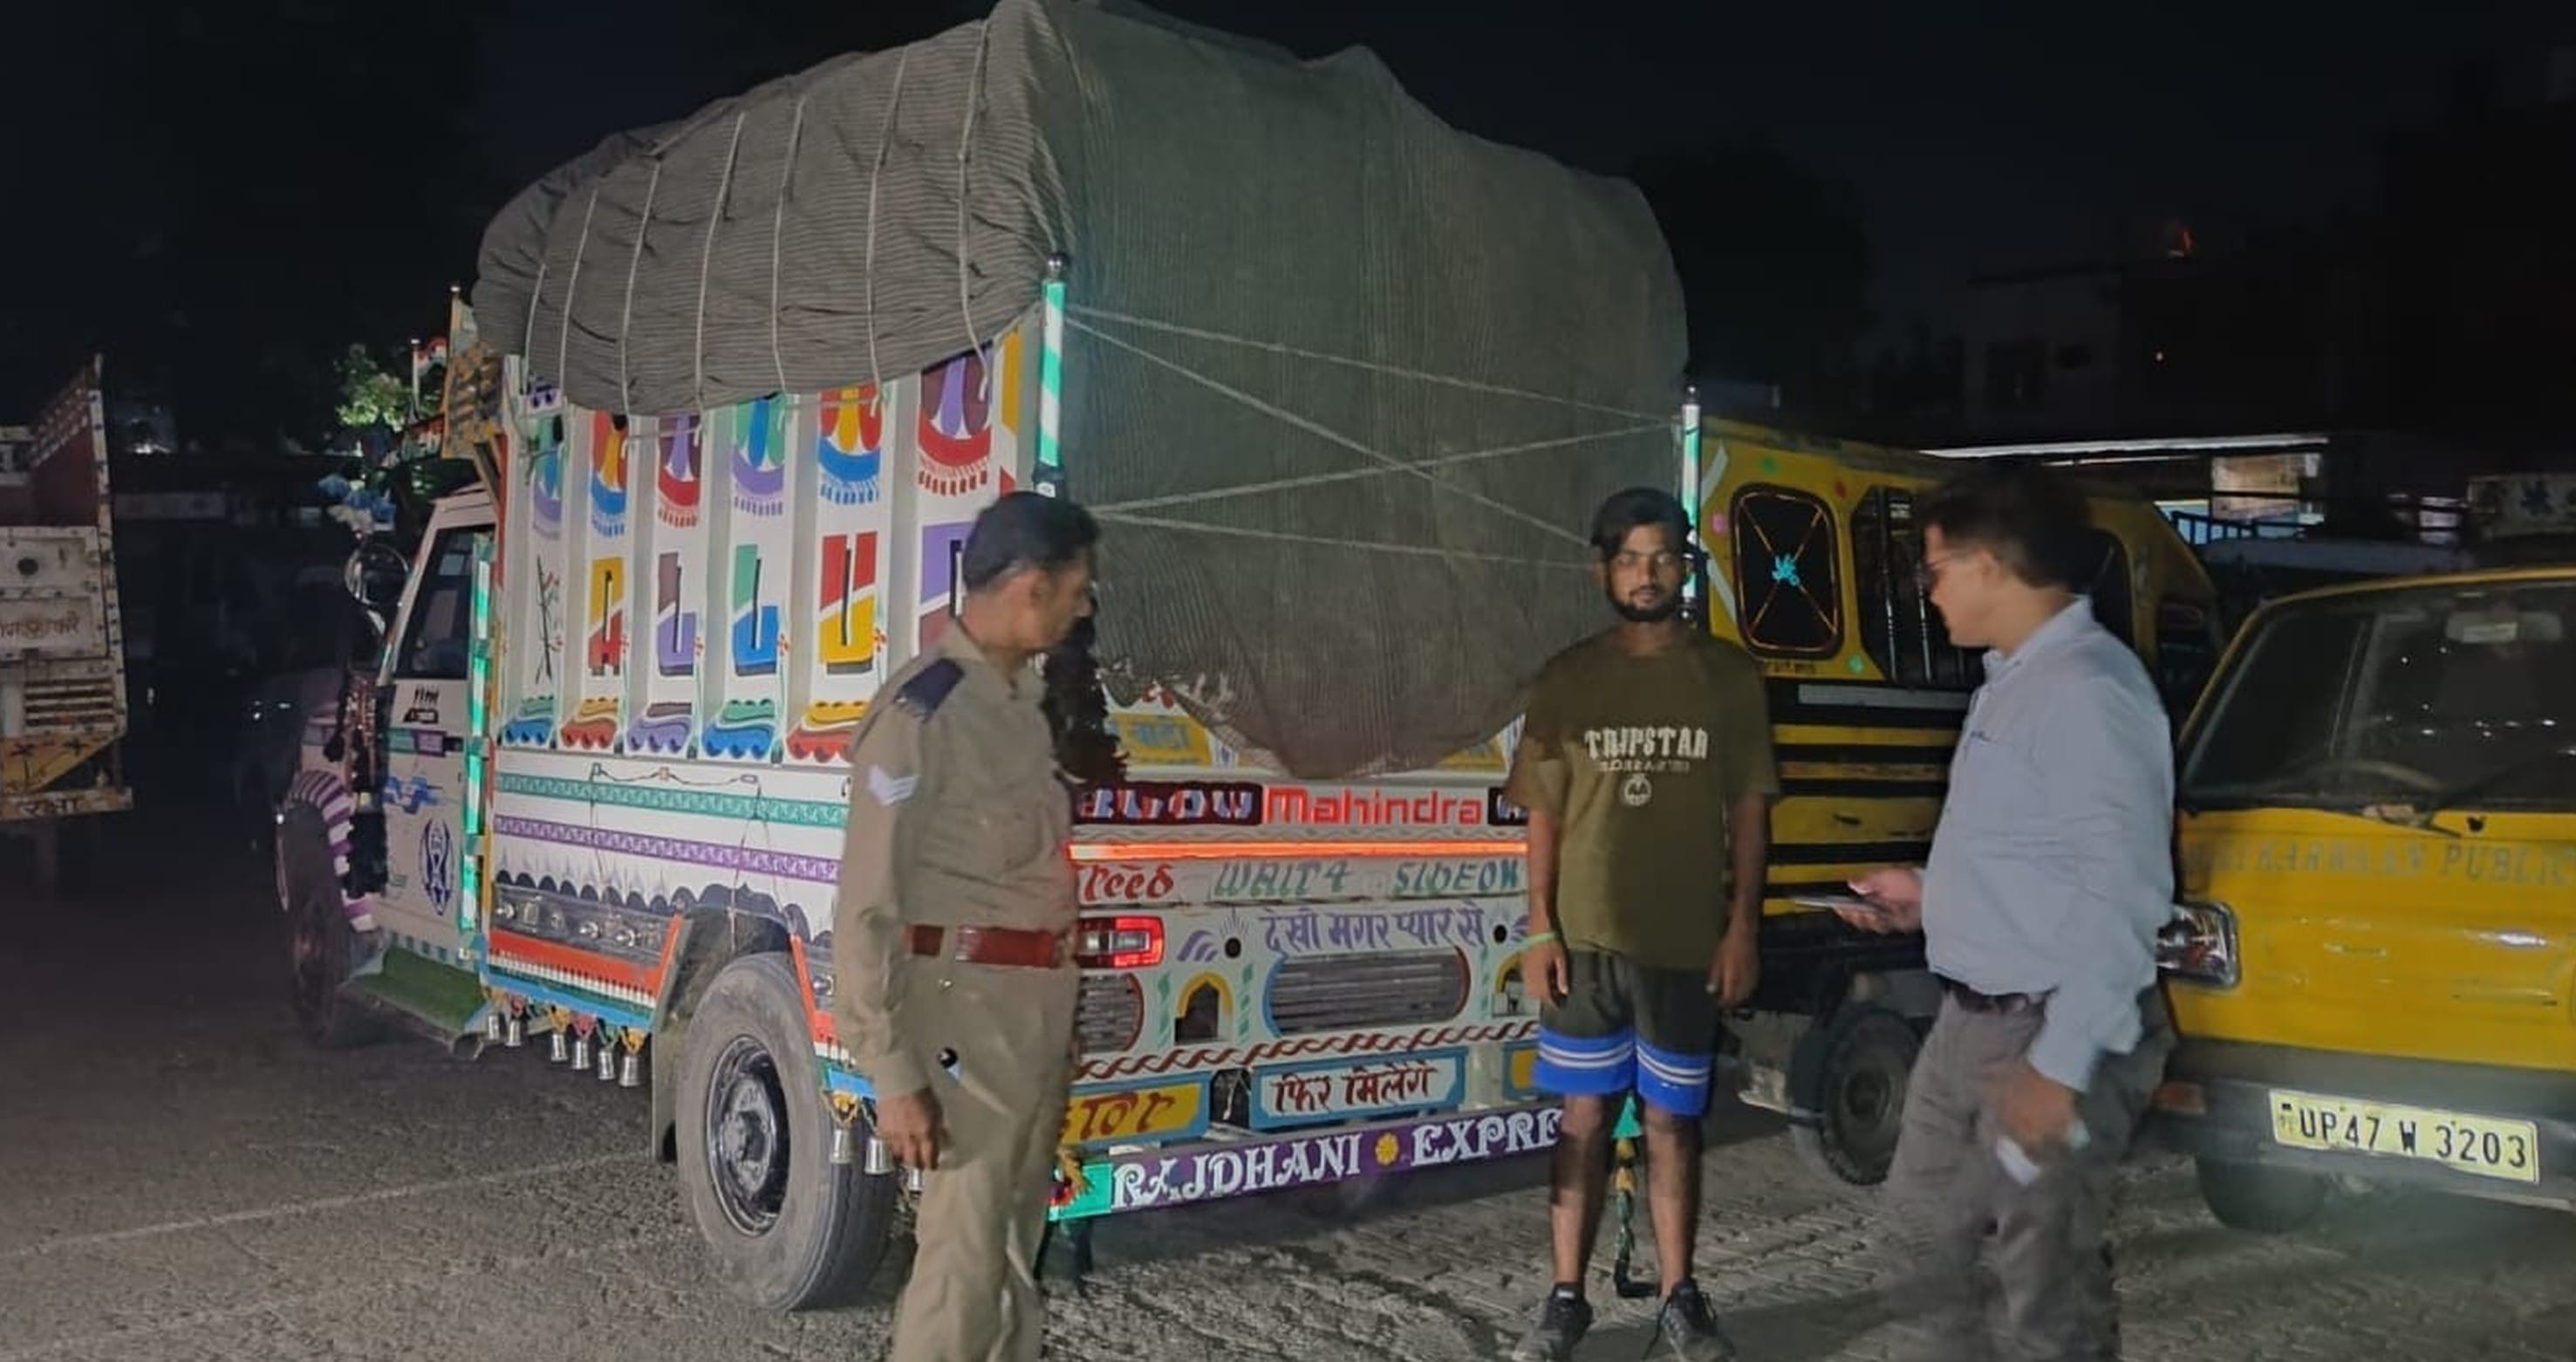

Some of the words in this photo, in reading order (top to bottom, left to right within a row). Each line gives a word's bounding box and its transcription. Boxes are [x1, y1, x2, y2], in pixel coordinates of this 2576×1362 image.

[1263, 787, 1482, 825] Mahindra
[1324, 913, 1391, 949] मगर
[1392, 907, 1455, 947] प्यार
[1457, 900, 1485, 948] से
[1271, 1071, 1331, 1112] फिर
[1111, 1133, 1362, 1212] RAJDHANI
[1411, 1108, 1563, 1167] EXPRE
[2299, 1108, 2380, 1150] UP47
[2399, 1119, 2417, 1154] W
[2436, 1125, 2526, 1168] 3203
